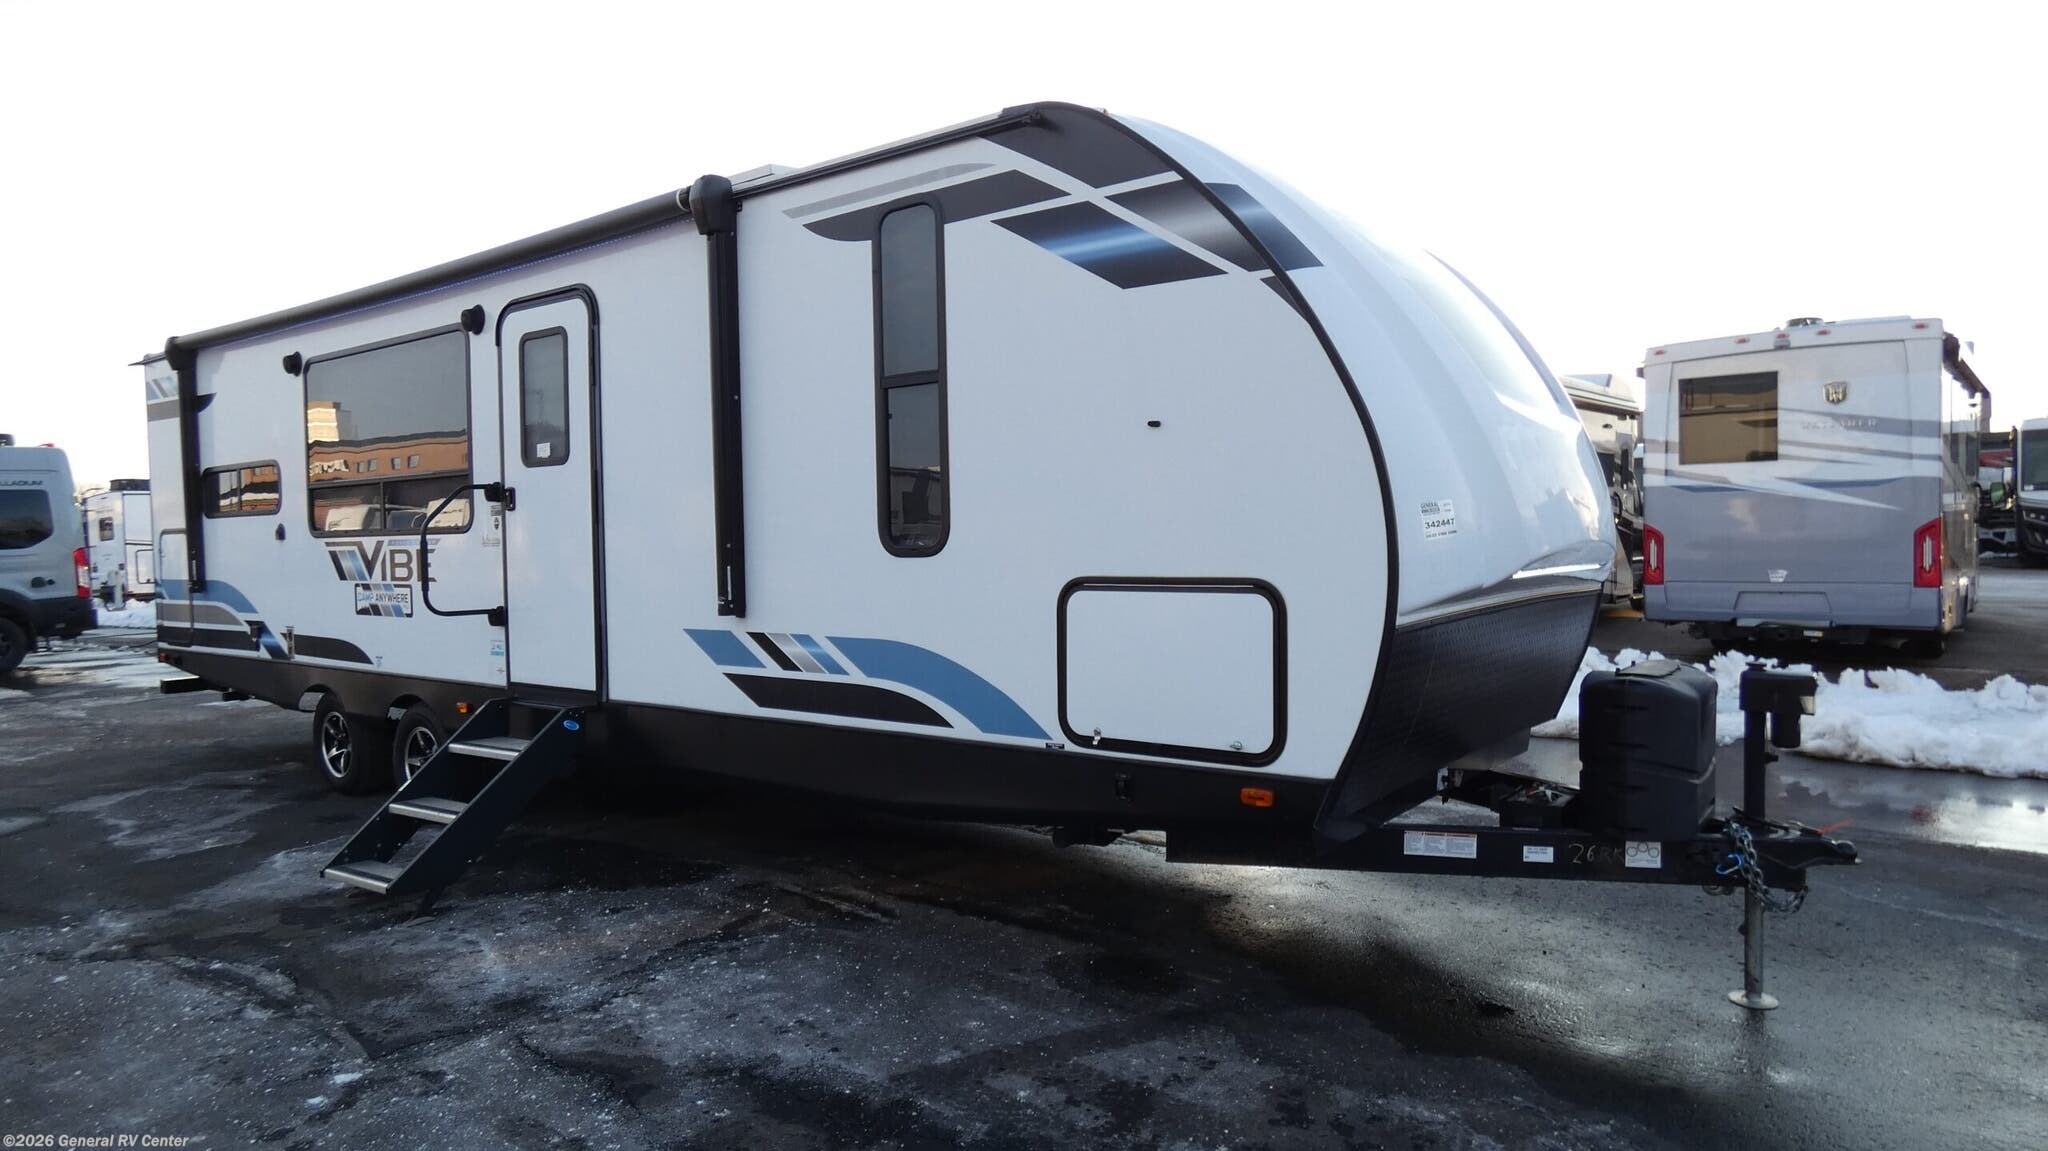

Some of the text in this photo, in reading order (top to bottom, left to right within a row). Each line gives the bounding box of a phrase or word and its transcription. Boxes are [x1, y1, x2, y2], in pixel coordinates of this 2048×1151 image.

[1424, 518, 1455, 530] 342447
[325, 540, 437, 583] VIBE
[357, 592, 409, 604] CAMP ANYWHERE
